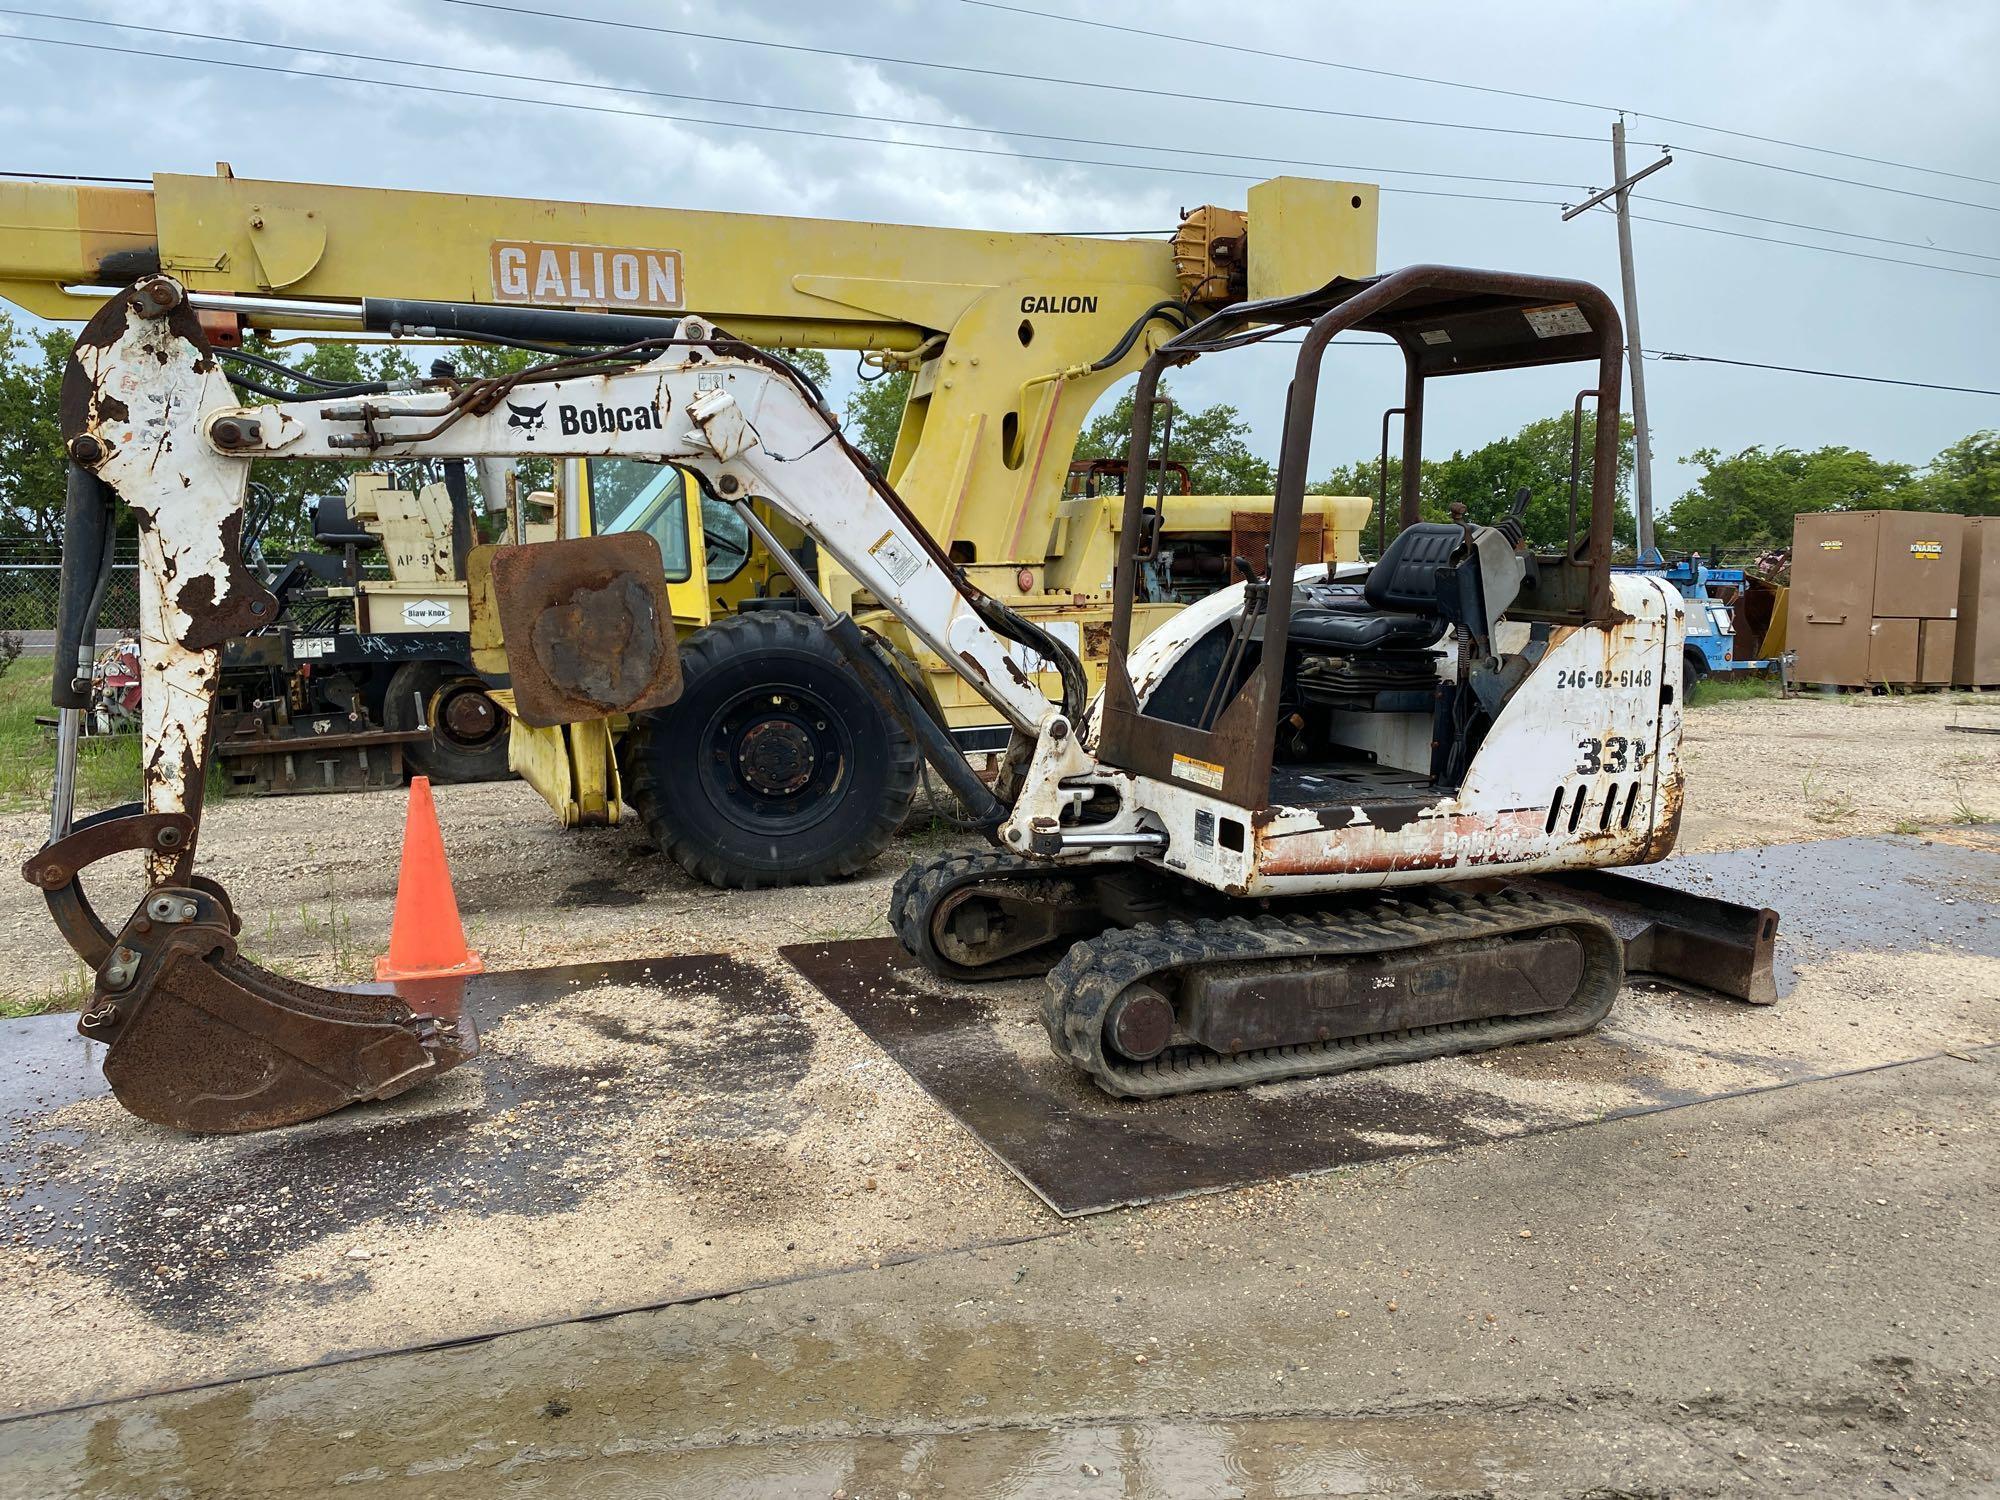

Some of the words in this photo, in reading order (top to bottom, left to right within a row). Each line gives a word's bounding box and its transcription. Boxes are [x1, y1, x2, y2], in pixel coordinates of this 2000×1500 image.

[499, 247, 676, 302] GALION
[1020, 296, 1098, 314] GALION
[559, 401, 662, 436] Bobcat
[1910, 543, 1942, 554] KNAACK
[408, 609, 446, 617] Blaw-Knox
[1557, 669, 1652, 689] 246-02-6148
[1576, 736, 1646, 775] 331
